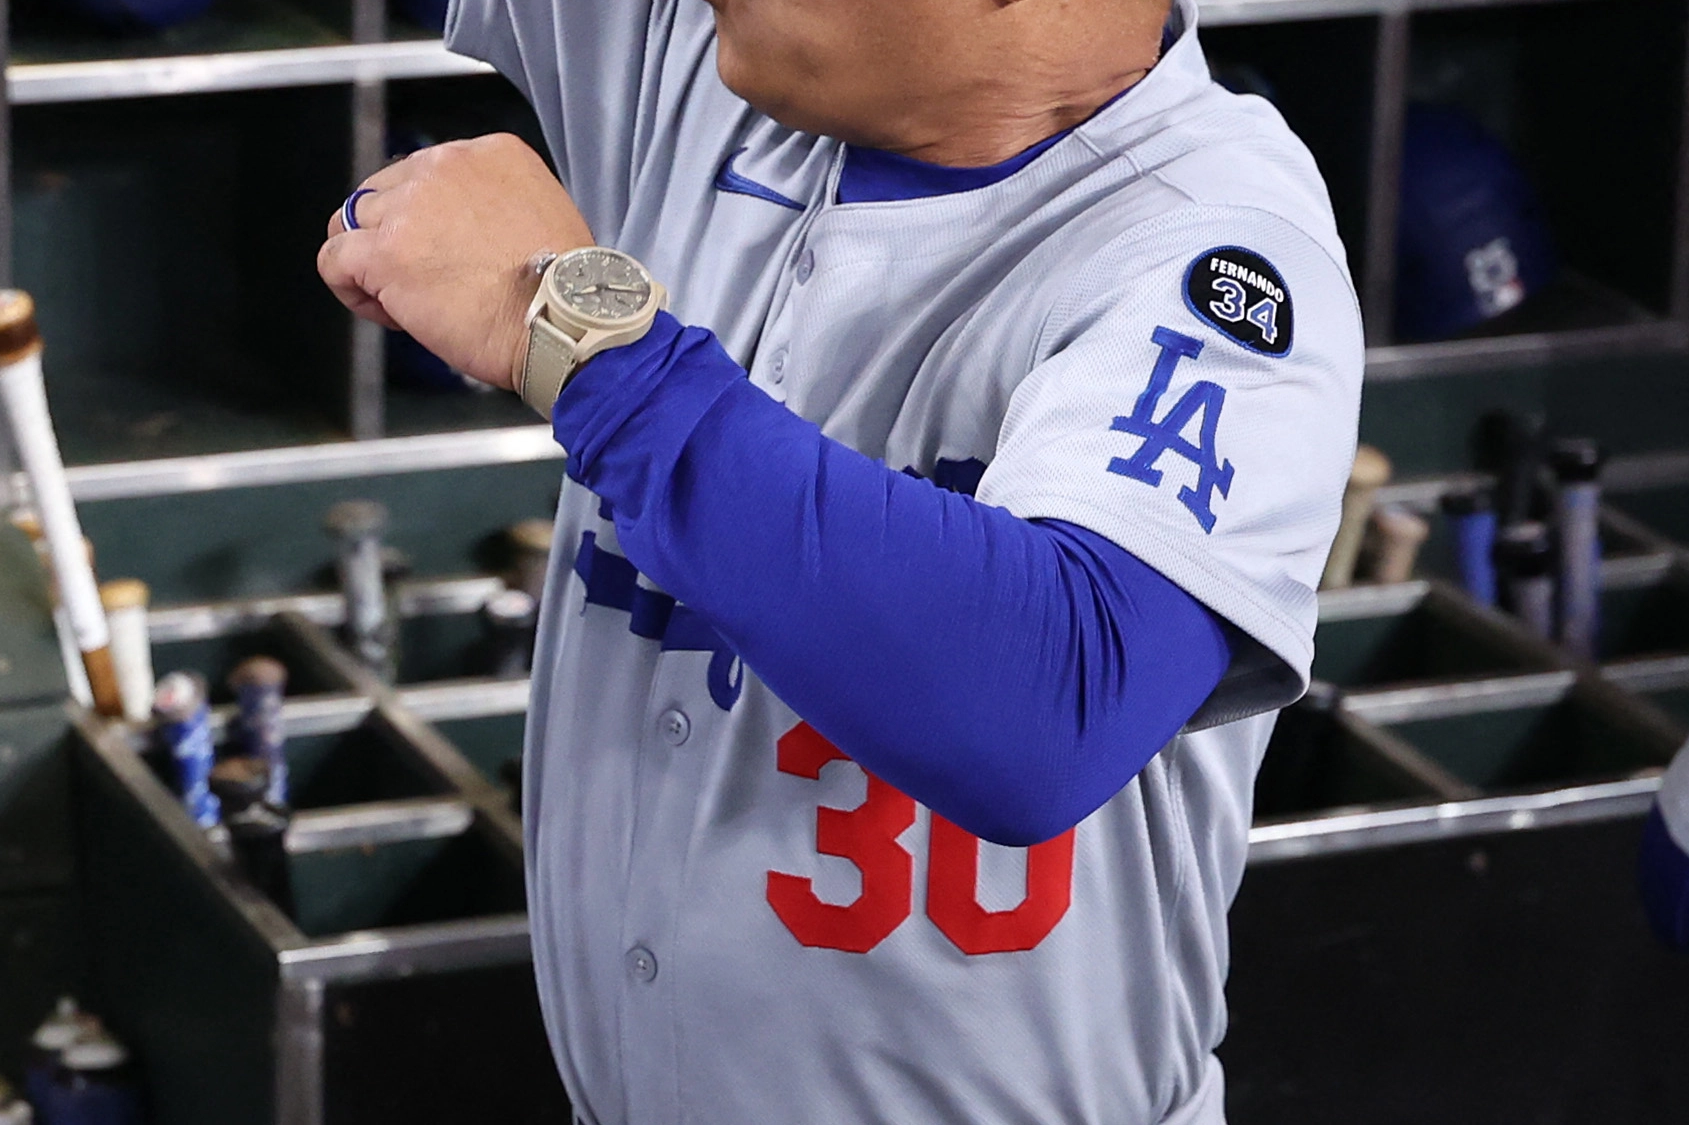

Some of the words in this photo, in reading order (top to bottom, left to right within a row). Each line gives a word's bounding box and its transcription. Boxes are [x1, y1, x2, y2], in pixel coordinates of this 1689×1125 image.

[1208, 276, 1278, 345] 34
[1209, 257, 1285, 303] FERNANDO
[1106, 325, 1235, 534] LA
[766, 720, 1077, 956] 30
